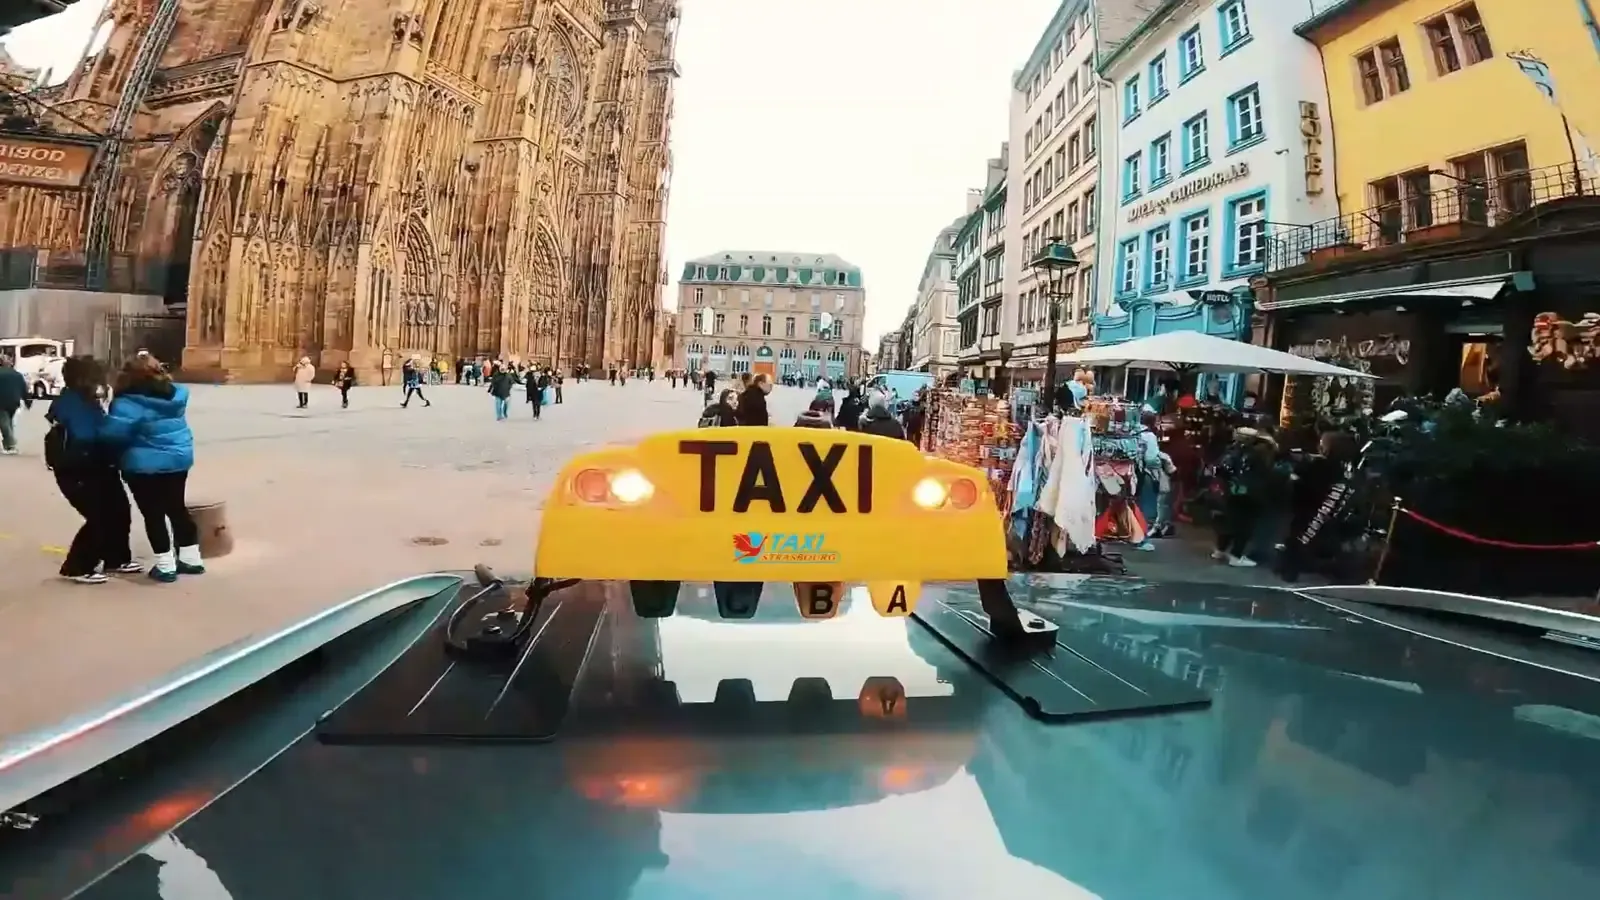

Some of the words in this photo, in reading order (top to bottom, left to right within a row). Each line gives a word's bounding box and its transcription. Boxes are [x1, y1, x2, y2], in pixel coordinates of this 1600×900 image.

[1298, 101, 1323, 196] HOTEL
[1206, 293, 1230, 302] HOTEL
[679, 440, 873, 513] TAXI
[771, 533, 825, 551] TAXI
[762, 553, 836, 561] STRASBOURG
[809, 584, 833, 614] B
[887, 585, 907, 613] A
